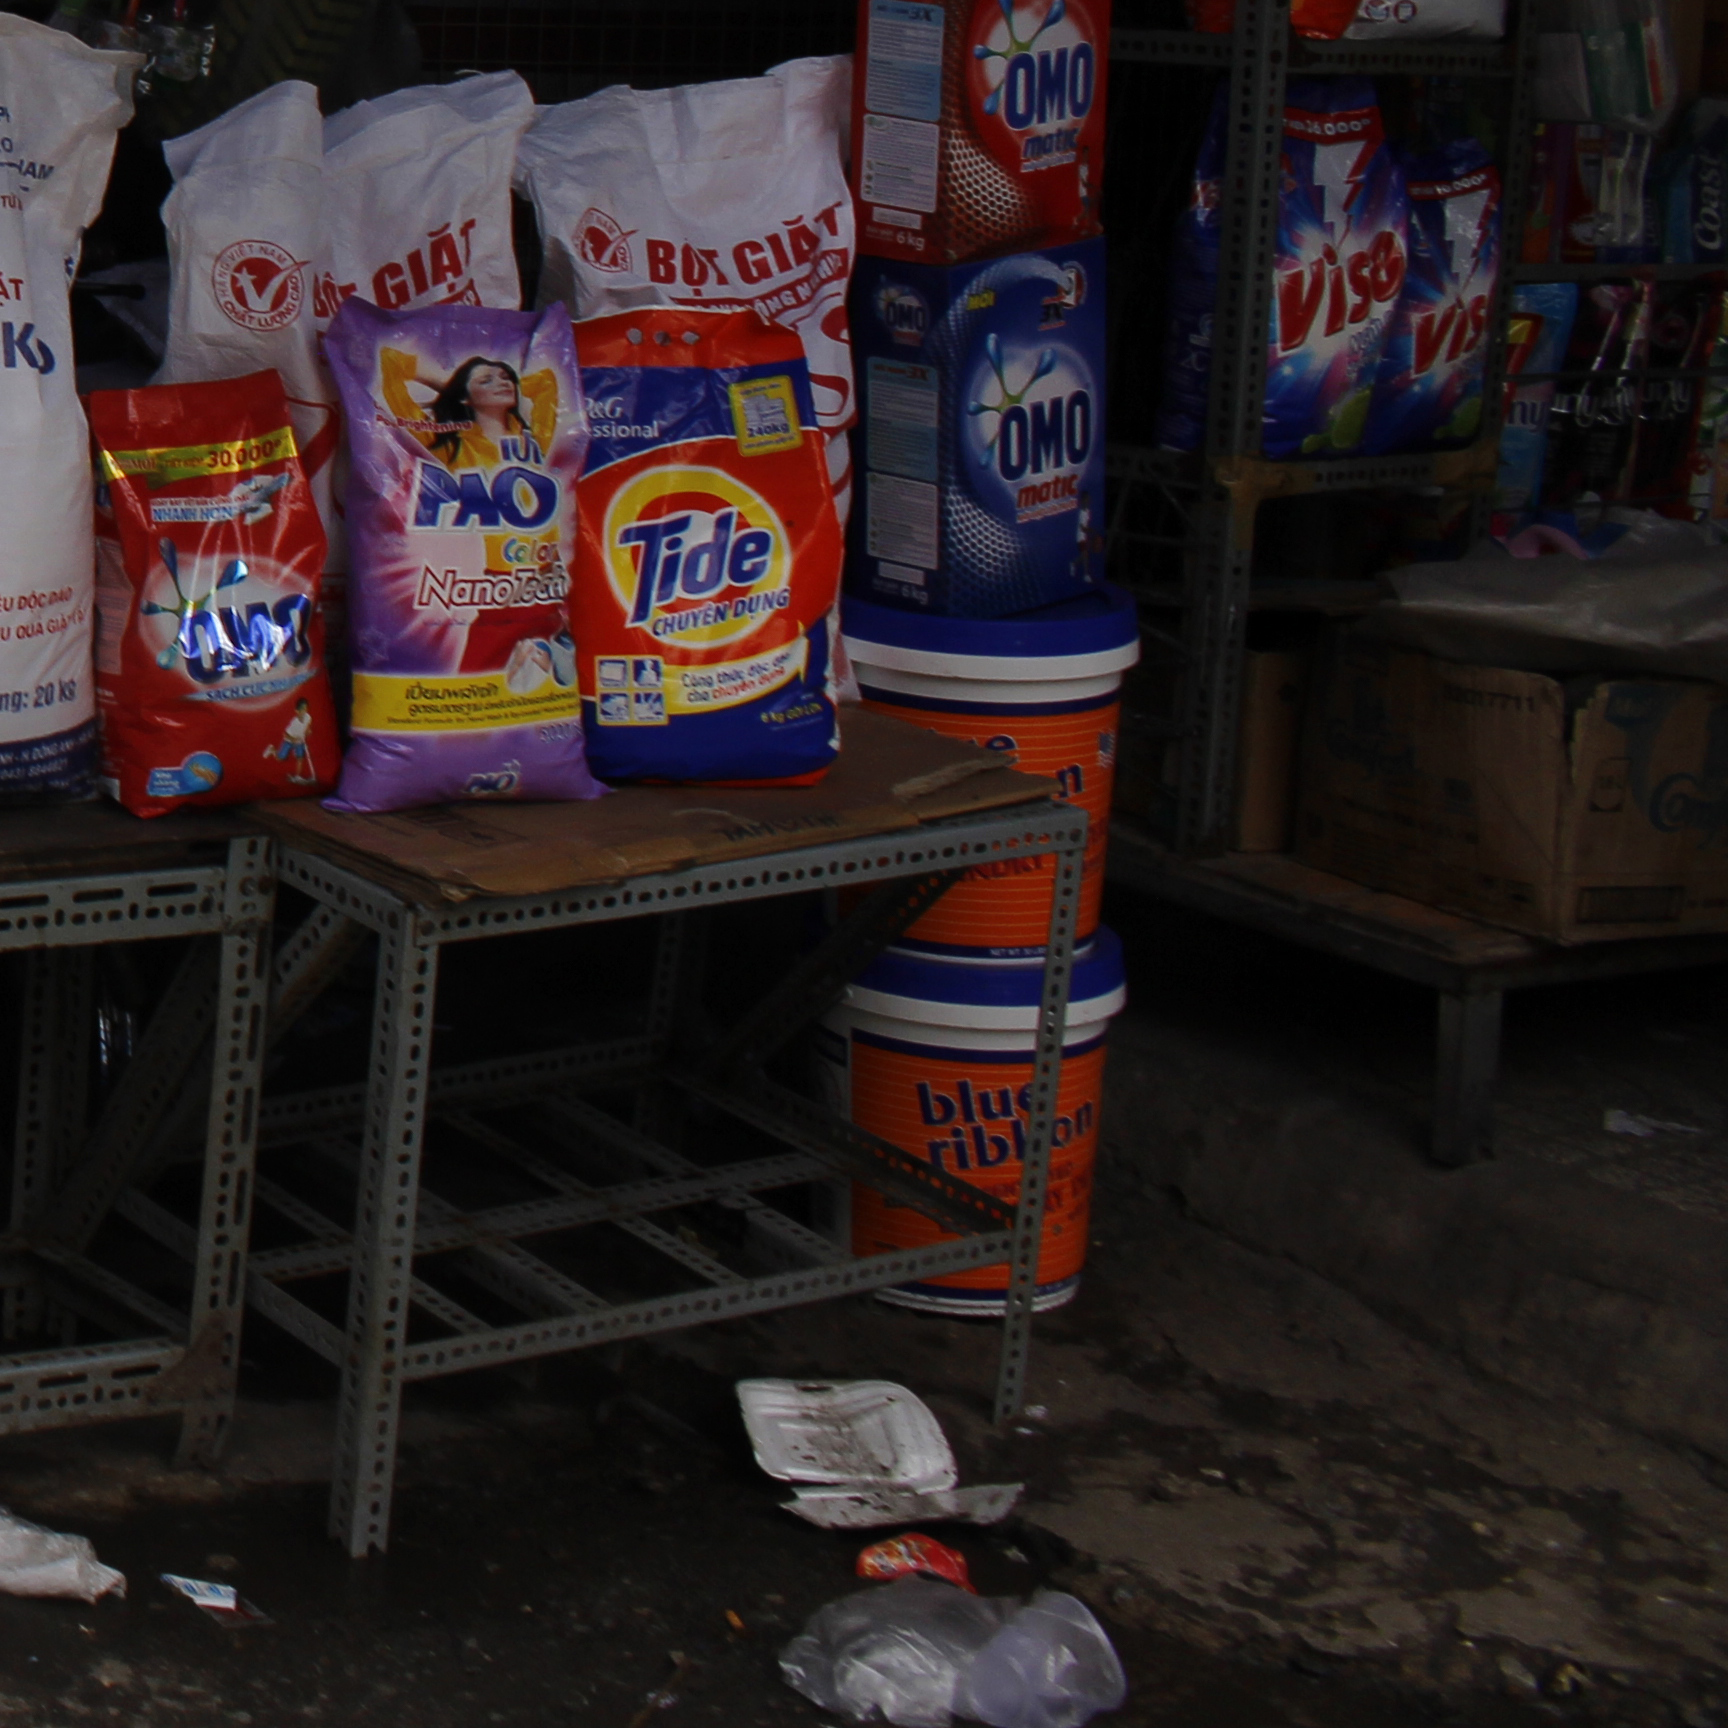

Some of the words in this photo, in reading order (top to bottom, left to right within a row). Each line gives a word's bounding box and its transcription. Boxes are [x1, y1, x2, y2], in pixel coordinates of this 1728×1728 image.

[1003, 42, 1095, 131] OMO
[1020, 125, 1079, 159] matic
[1696, 148, 1722, 252] Coast
[258, 245, 288, 266] NAM
[372, 218, 476, 310] GIẶT
[646, 238, 729, 297] BỘT
[732, 201, 842, 286] GIẶT
[908, 233, 926, 254] kg
[884, 300, 927, 334] OMO
[1277, 230, 1406, 354] Viso
[998, 391, 1092, 482] OMO
[153, 507, 198, 522] NHANH
[412, 460, 558, 529] PAO
[1014, 476, 1079, 511] matic
[617, 506, 774, 626] Tide
[651, 599, 731, 638] CHUYÊN
[734, 587, 791, 620] DỤNG
[34, 680, 55, 708] 20
